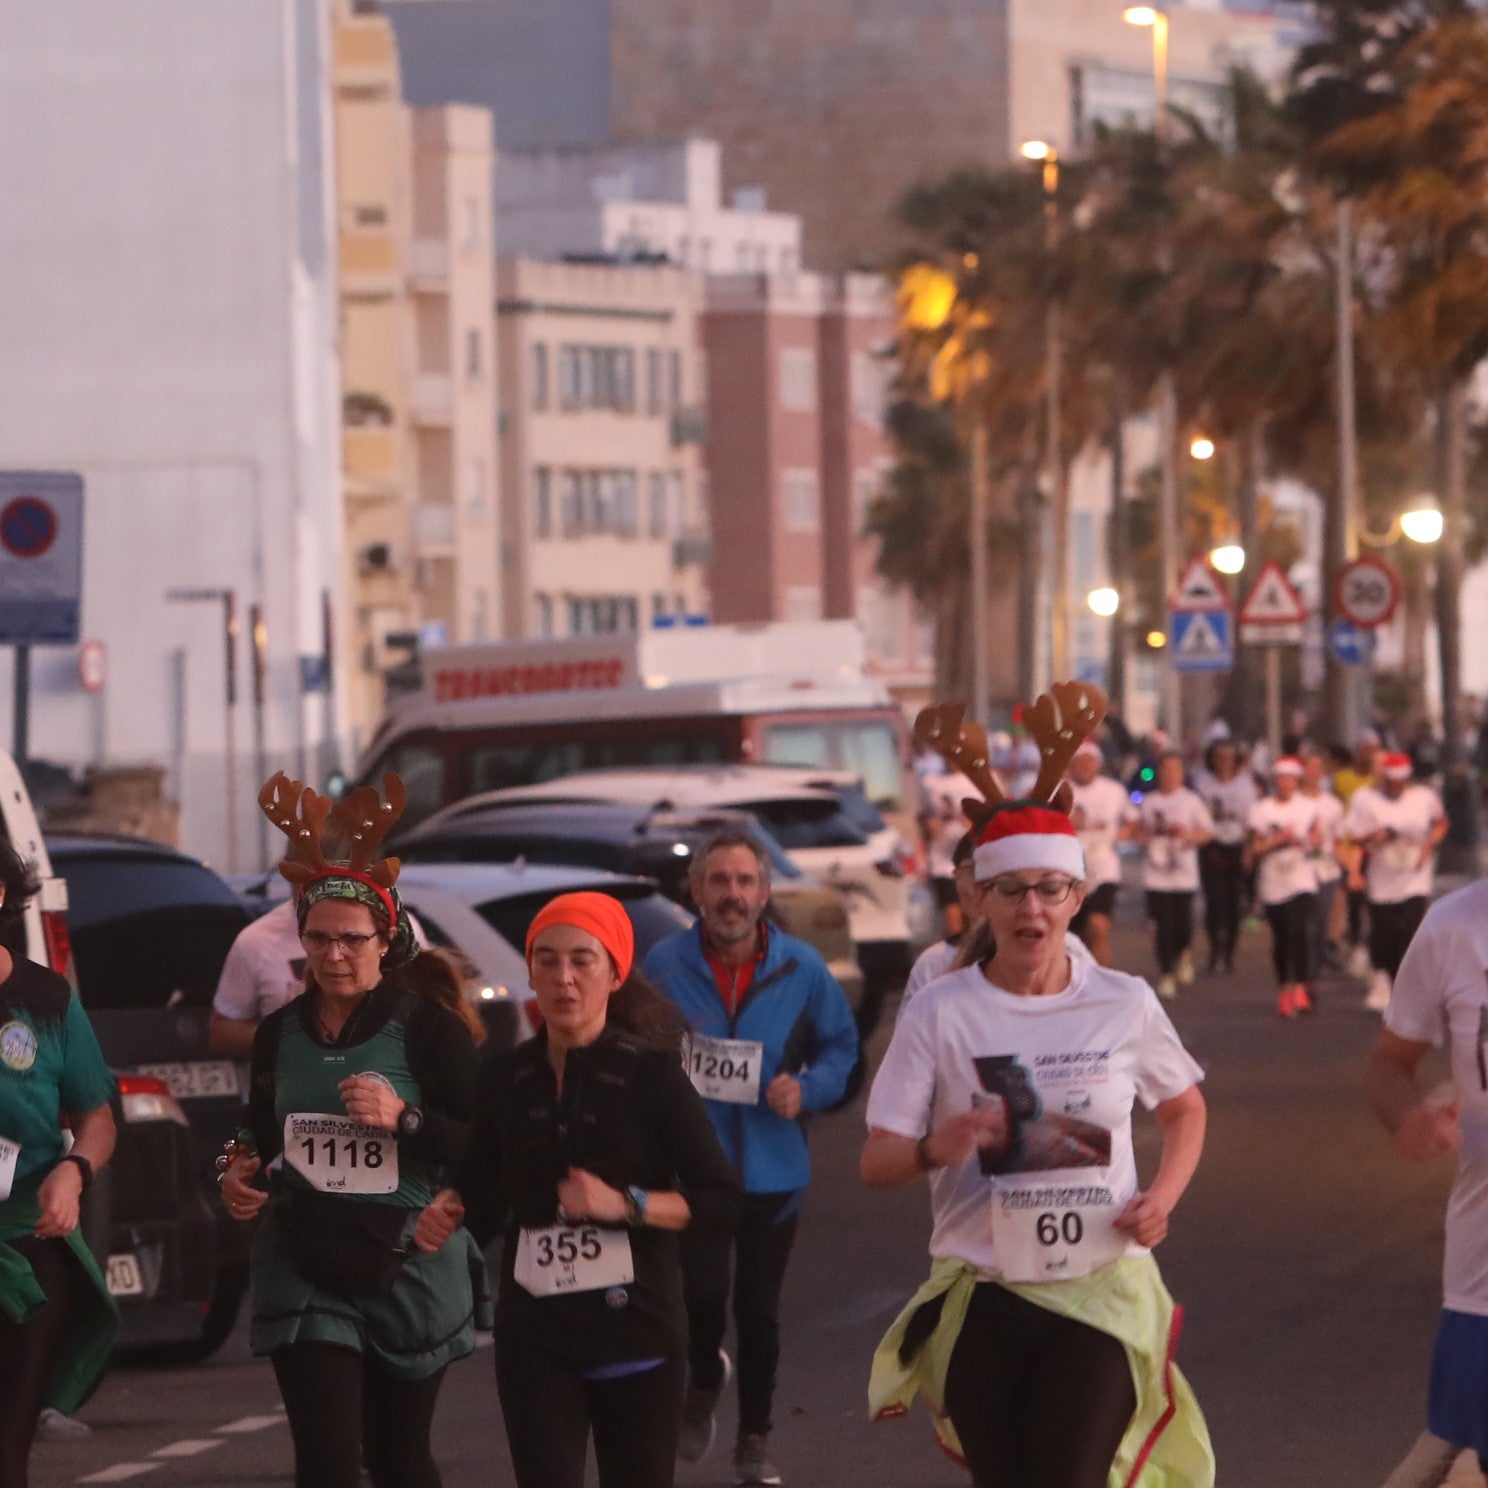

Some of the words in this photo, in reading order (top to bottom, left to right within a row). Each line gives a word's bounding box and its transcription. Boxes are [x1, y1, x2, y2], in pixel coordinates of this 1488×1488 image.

[693, 1051, 749, 1082] 1204
[292, 1125, 336, 1135] CIUDAD
[301, 1137, 384, 1169] 1118
[1037, 1212, 1083, 1247] 60
[536, 1228, 602, 1267] 355
